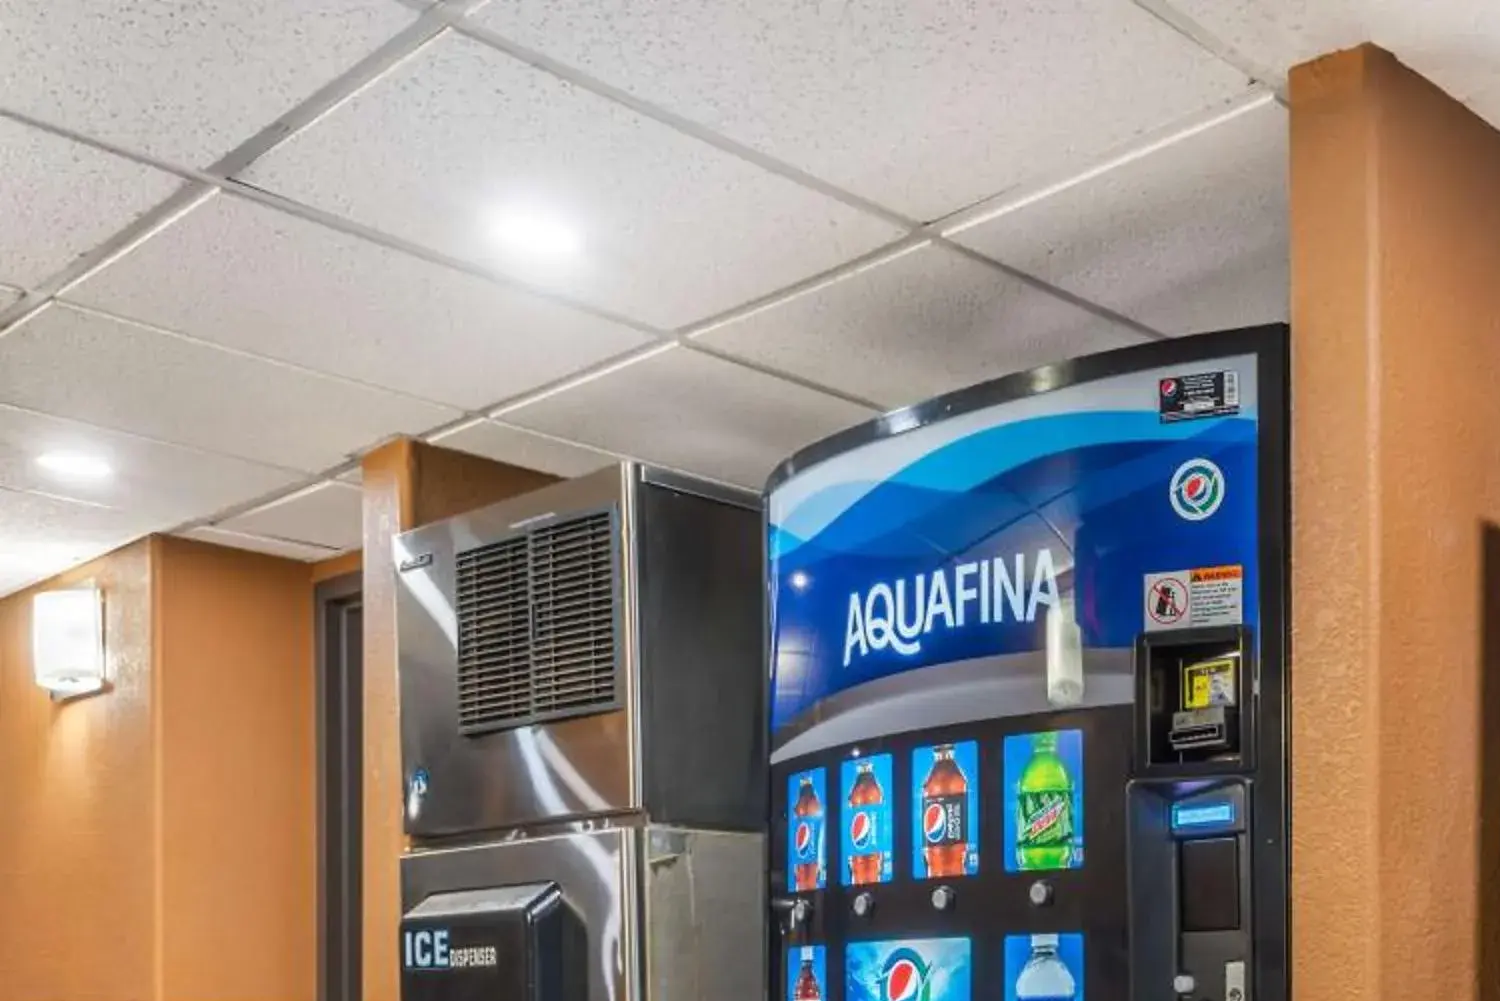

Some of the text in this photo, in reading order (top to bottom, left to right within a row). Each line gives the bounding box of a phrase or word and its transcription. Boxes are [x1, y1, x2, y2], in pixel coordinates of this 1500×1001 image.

[843, 548, 1060, 667] AQUAFINA
[404, 930, 497, 968] ICE DISPENSER
